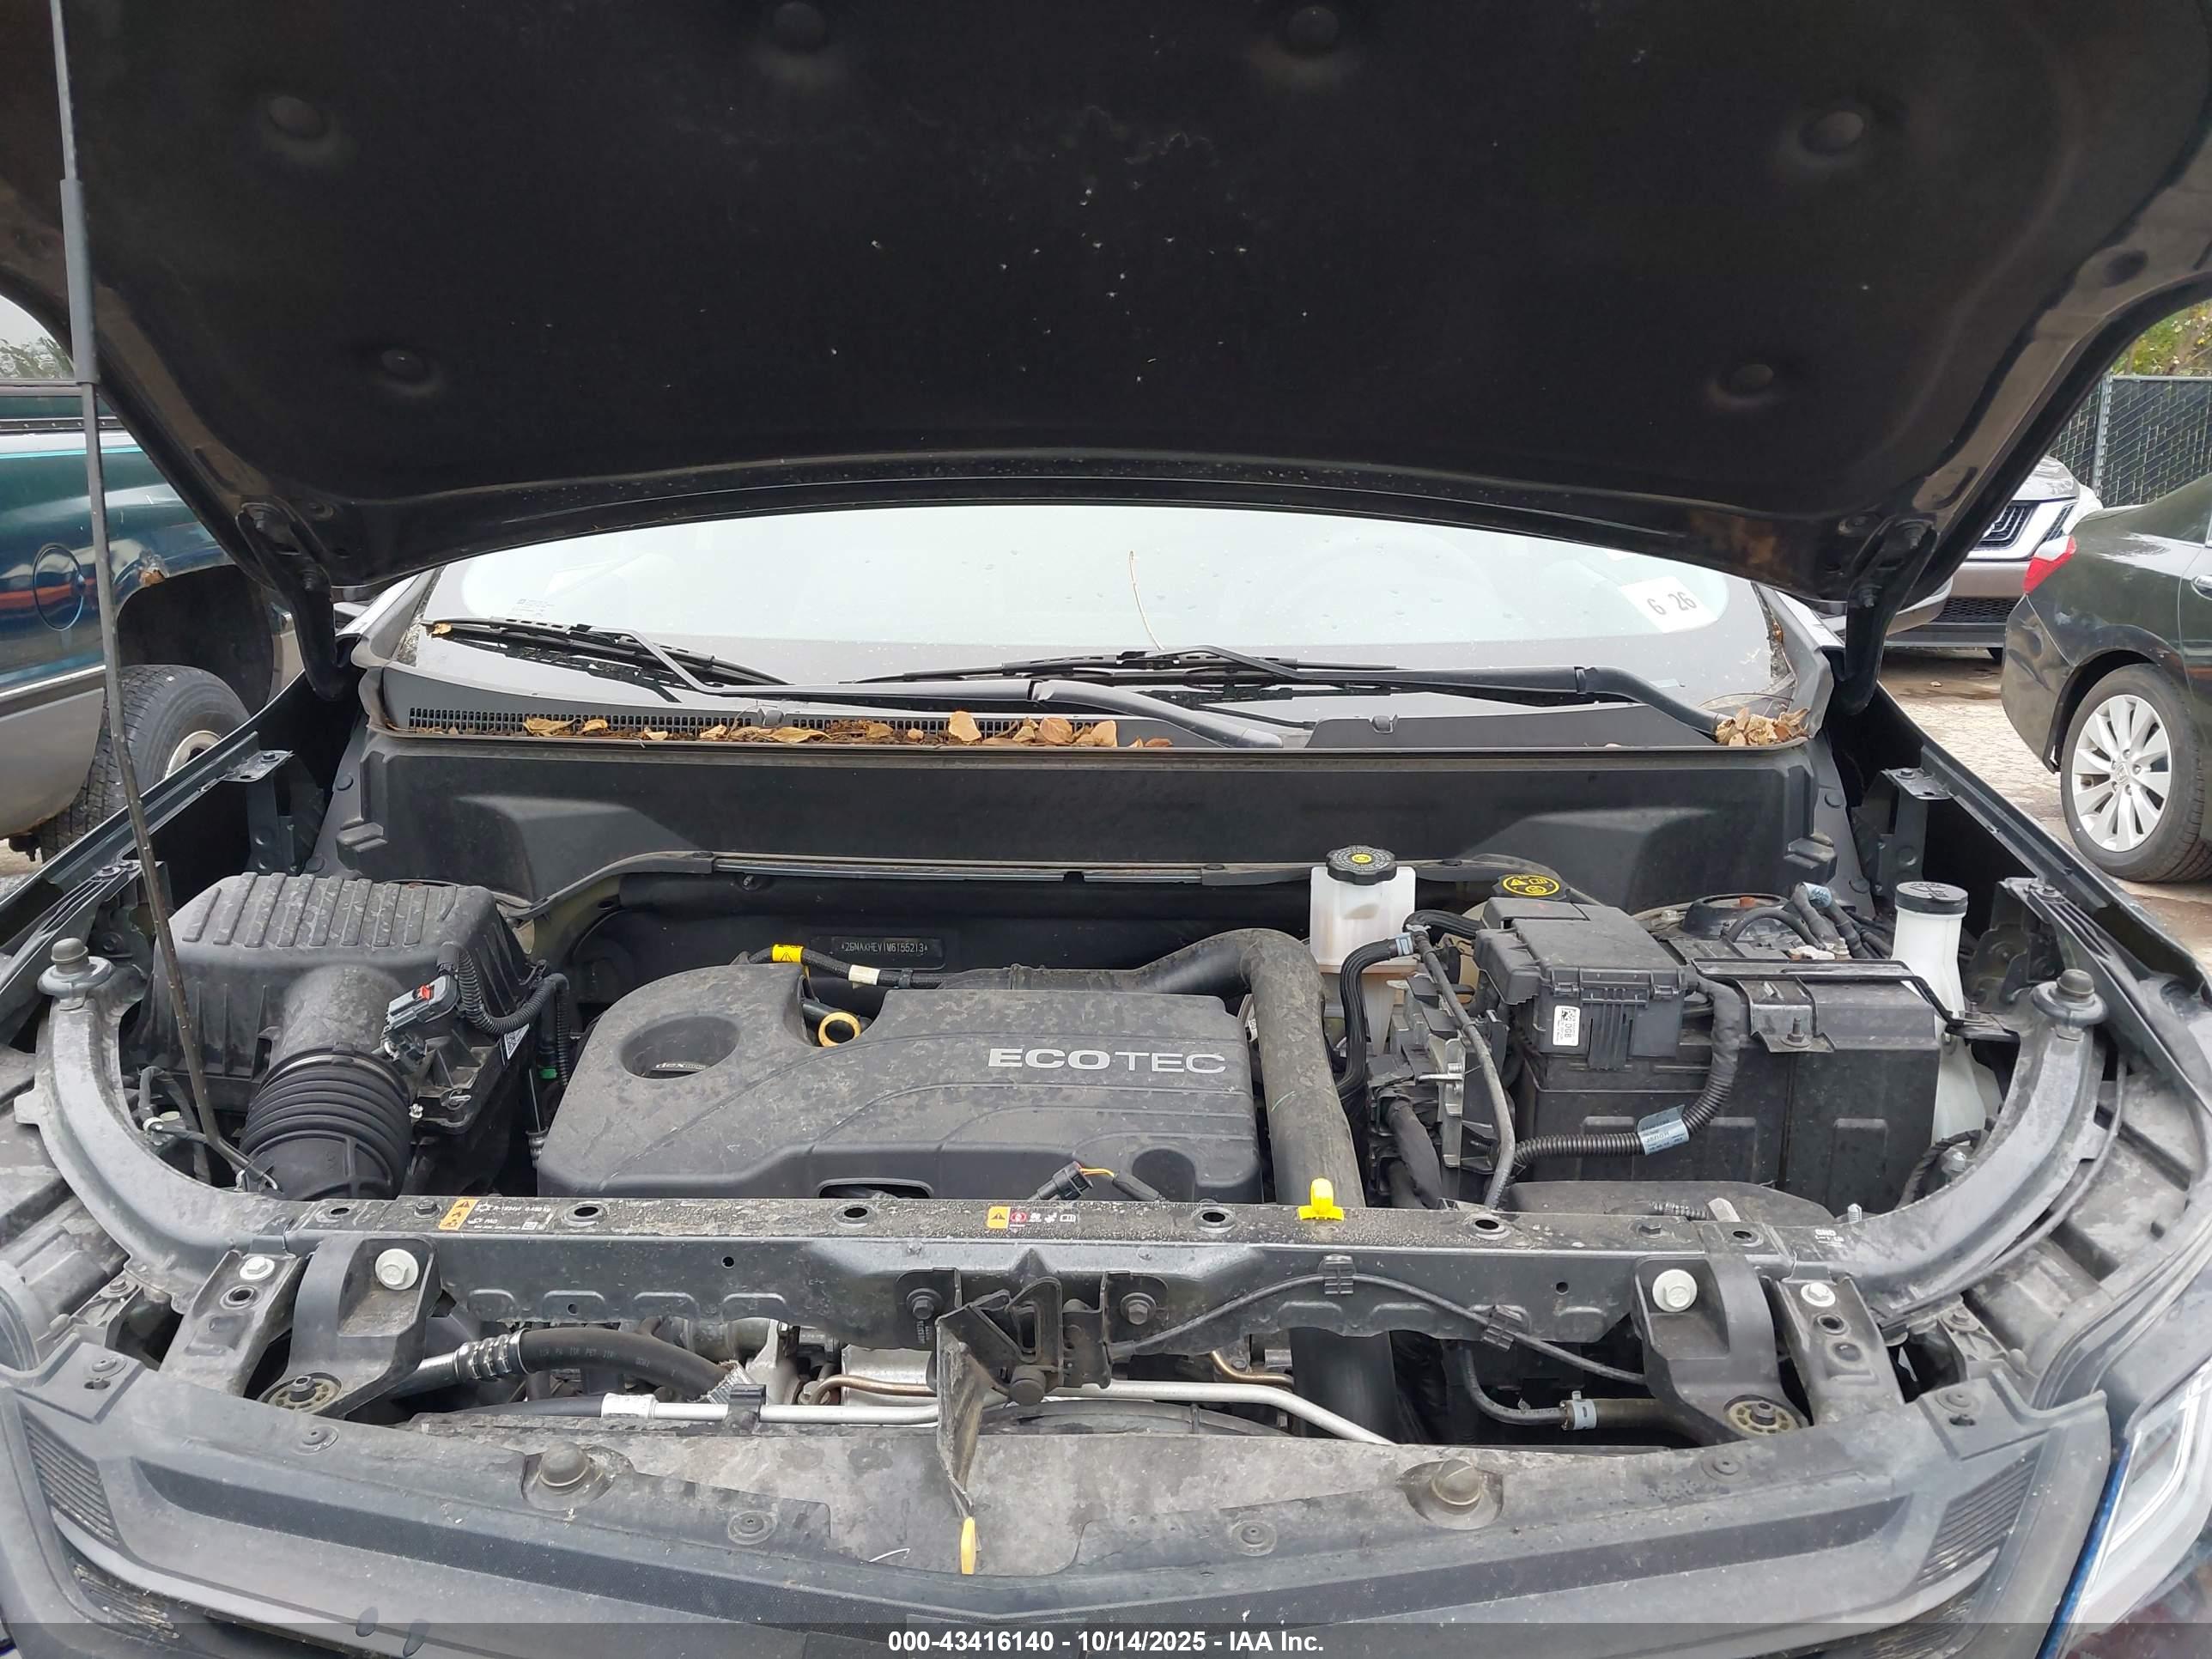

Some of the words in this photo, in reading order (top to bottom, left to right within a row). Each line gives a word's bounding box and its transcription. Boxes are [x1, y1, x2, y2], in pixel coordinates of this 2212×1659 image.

[1646, 598, 1667, 616] 6
[1667, 591, 1698, 611] 26
[988, 1047, 1227, 1074] ECOTEC
